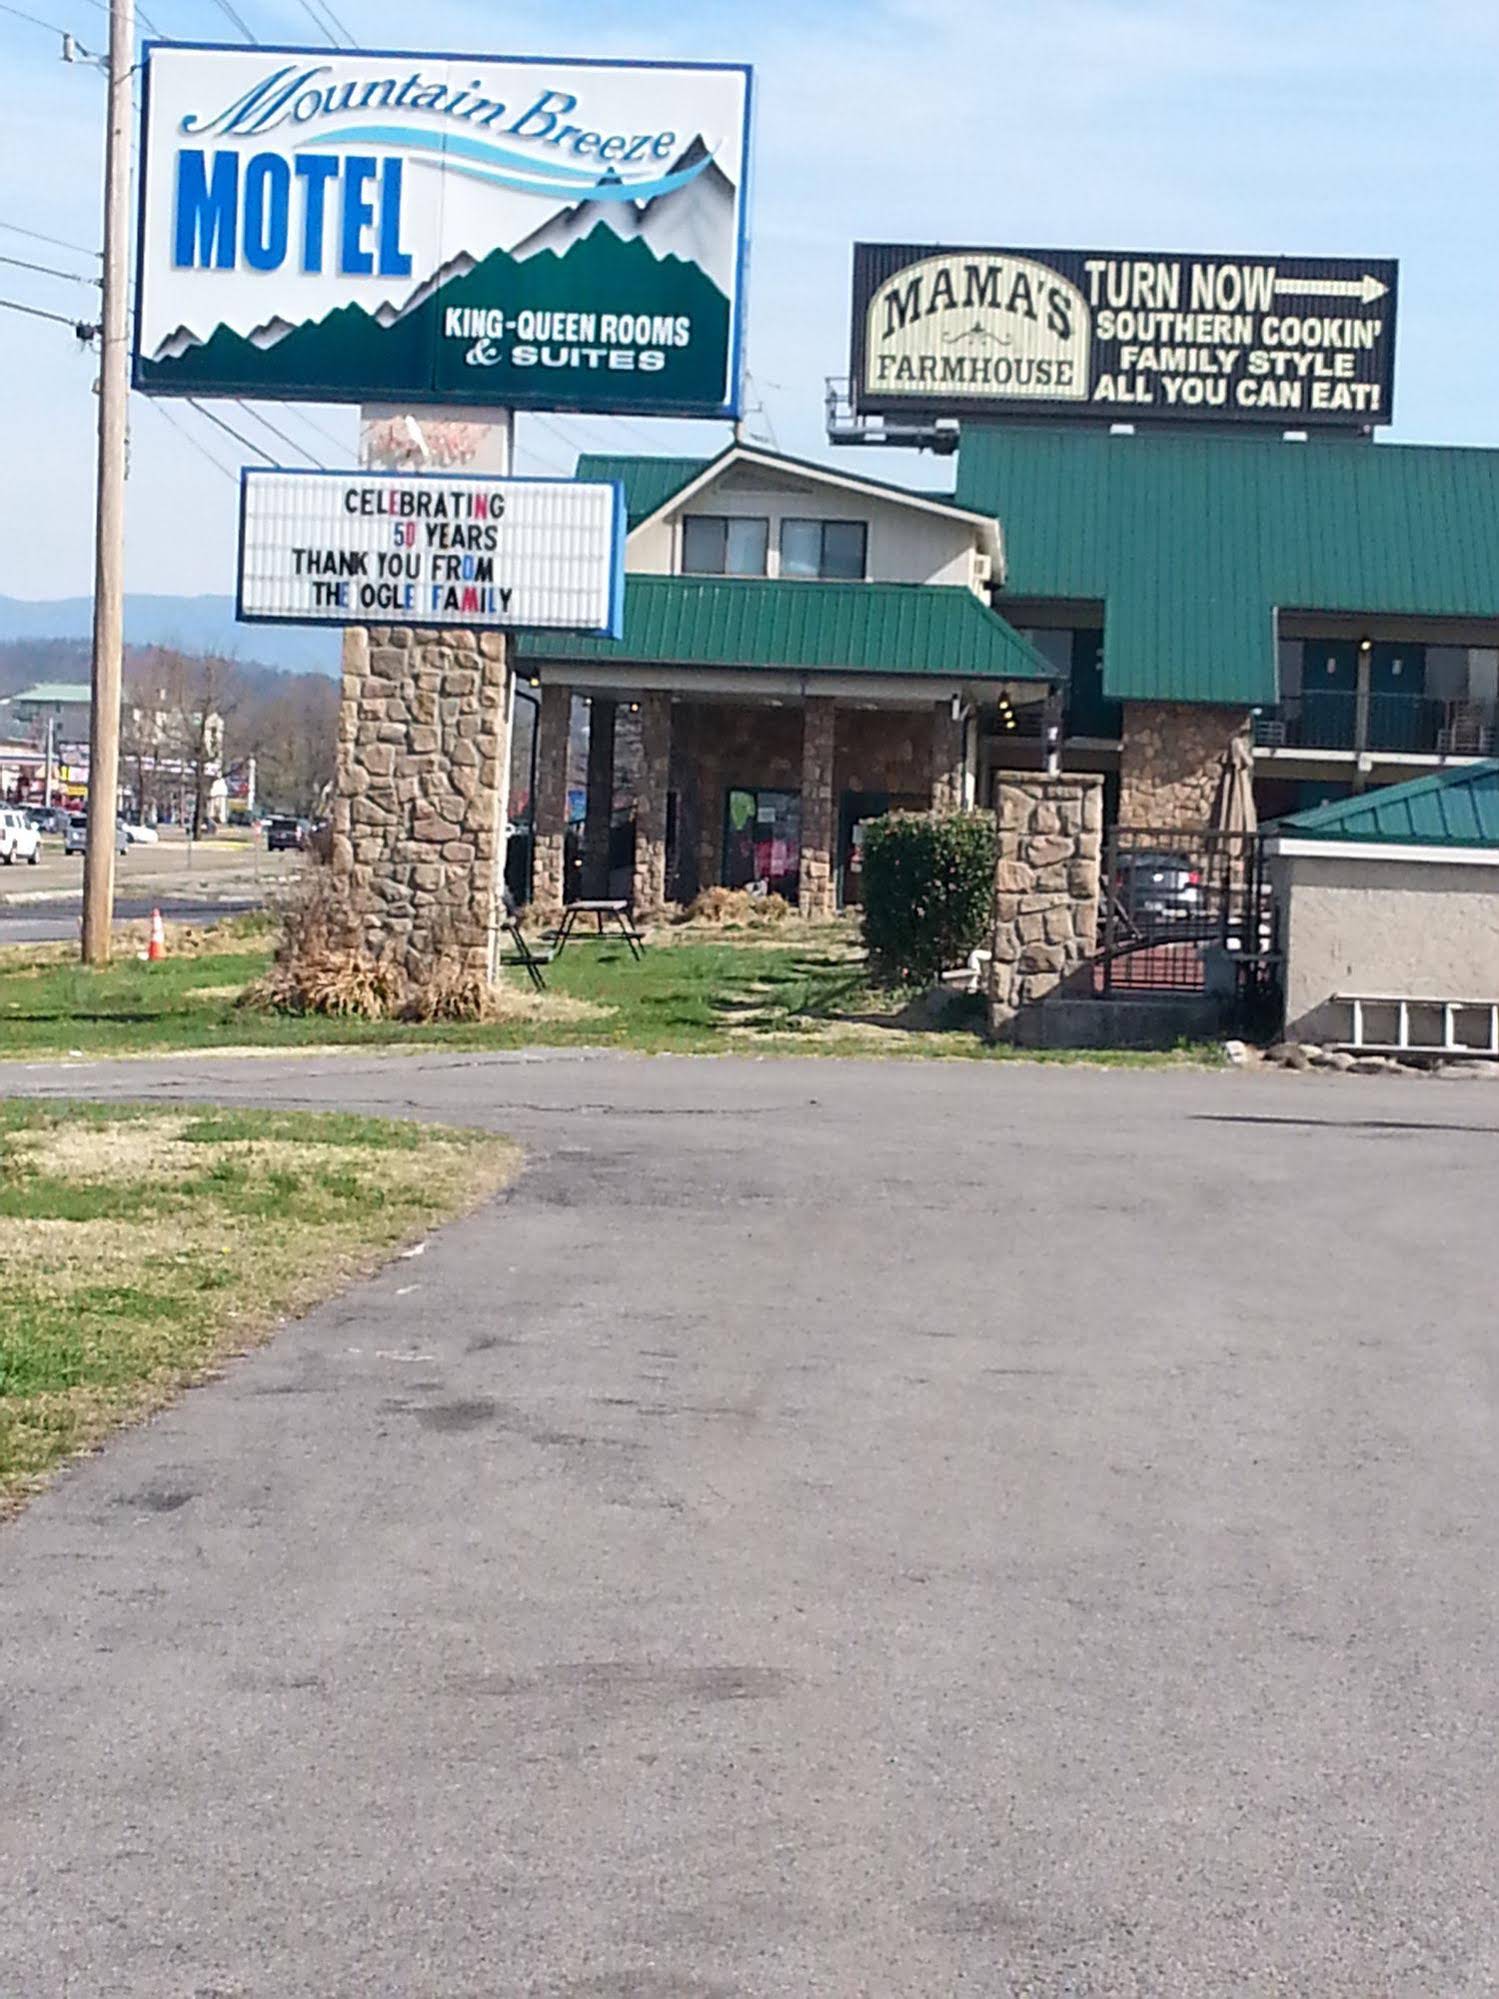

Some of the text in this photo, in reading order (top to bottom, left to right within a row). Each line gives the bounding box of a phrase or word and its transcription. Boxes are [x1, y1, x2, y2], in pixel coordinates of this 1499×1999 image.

[182, 65, 676, 162] Mountain Breeze
[173, 149, 413, 277] MOTEL
[882, 264, 1073, 341] MAMA'S
[1084, 259, 1276, 314] TURN NOW
[600, 314, 692, 348] ROOMS
[1096, 312, 1382, 349] SOUTHERN COOKIN'
[465, 337, 667, 372] & SUITES
[876, 354, 1074, 387] FARMHOUSE
[1120, 345, 1355, 379] FAMILY STYLE
[1093, 377, 1381, 411] ALL YOU CAN EAT!
[344, 489, 505, 519] CELEBRATING
[393, 523, 498, 551] 50 YEARS
[292, 548, 494, 582] THANK YOU FROM
[313, 581, 512, 613] THE OGLE FAMILY
